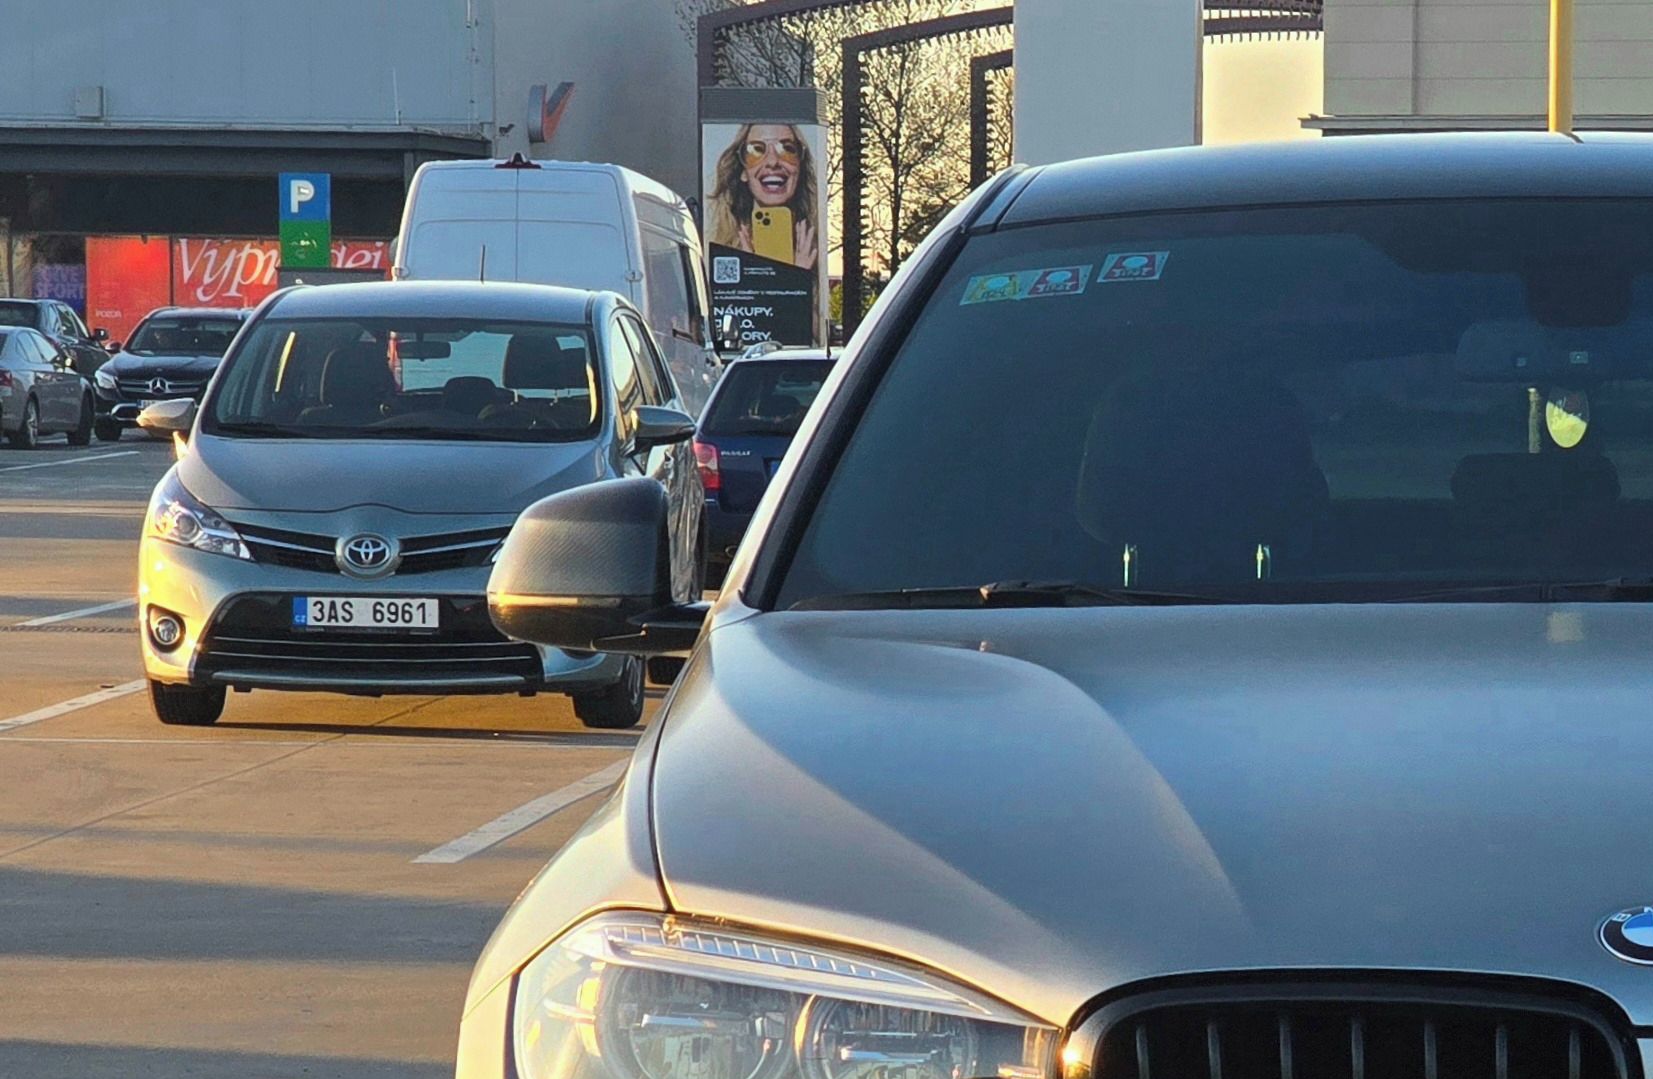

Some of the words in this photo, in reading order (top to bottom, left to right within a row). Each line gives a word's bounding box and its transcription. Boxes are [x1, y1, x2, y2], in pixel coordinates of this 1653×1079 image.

[289, 179, 316, 213] P
[713, 304, 774, 317] NÁKUPY.
[312, 600, 354, 624] 3AS
[372, 601, 427, 625] 6961
